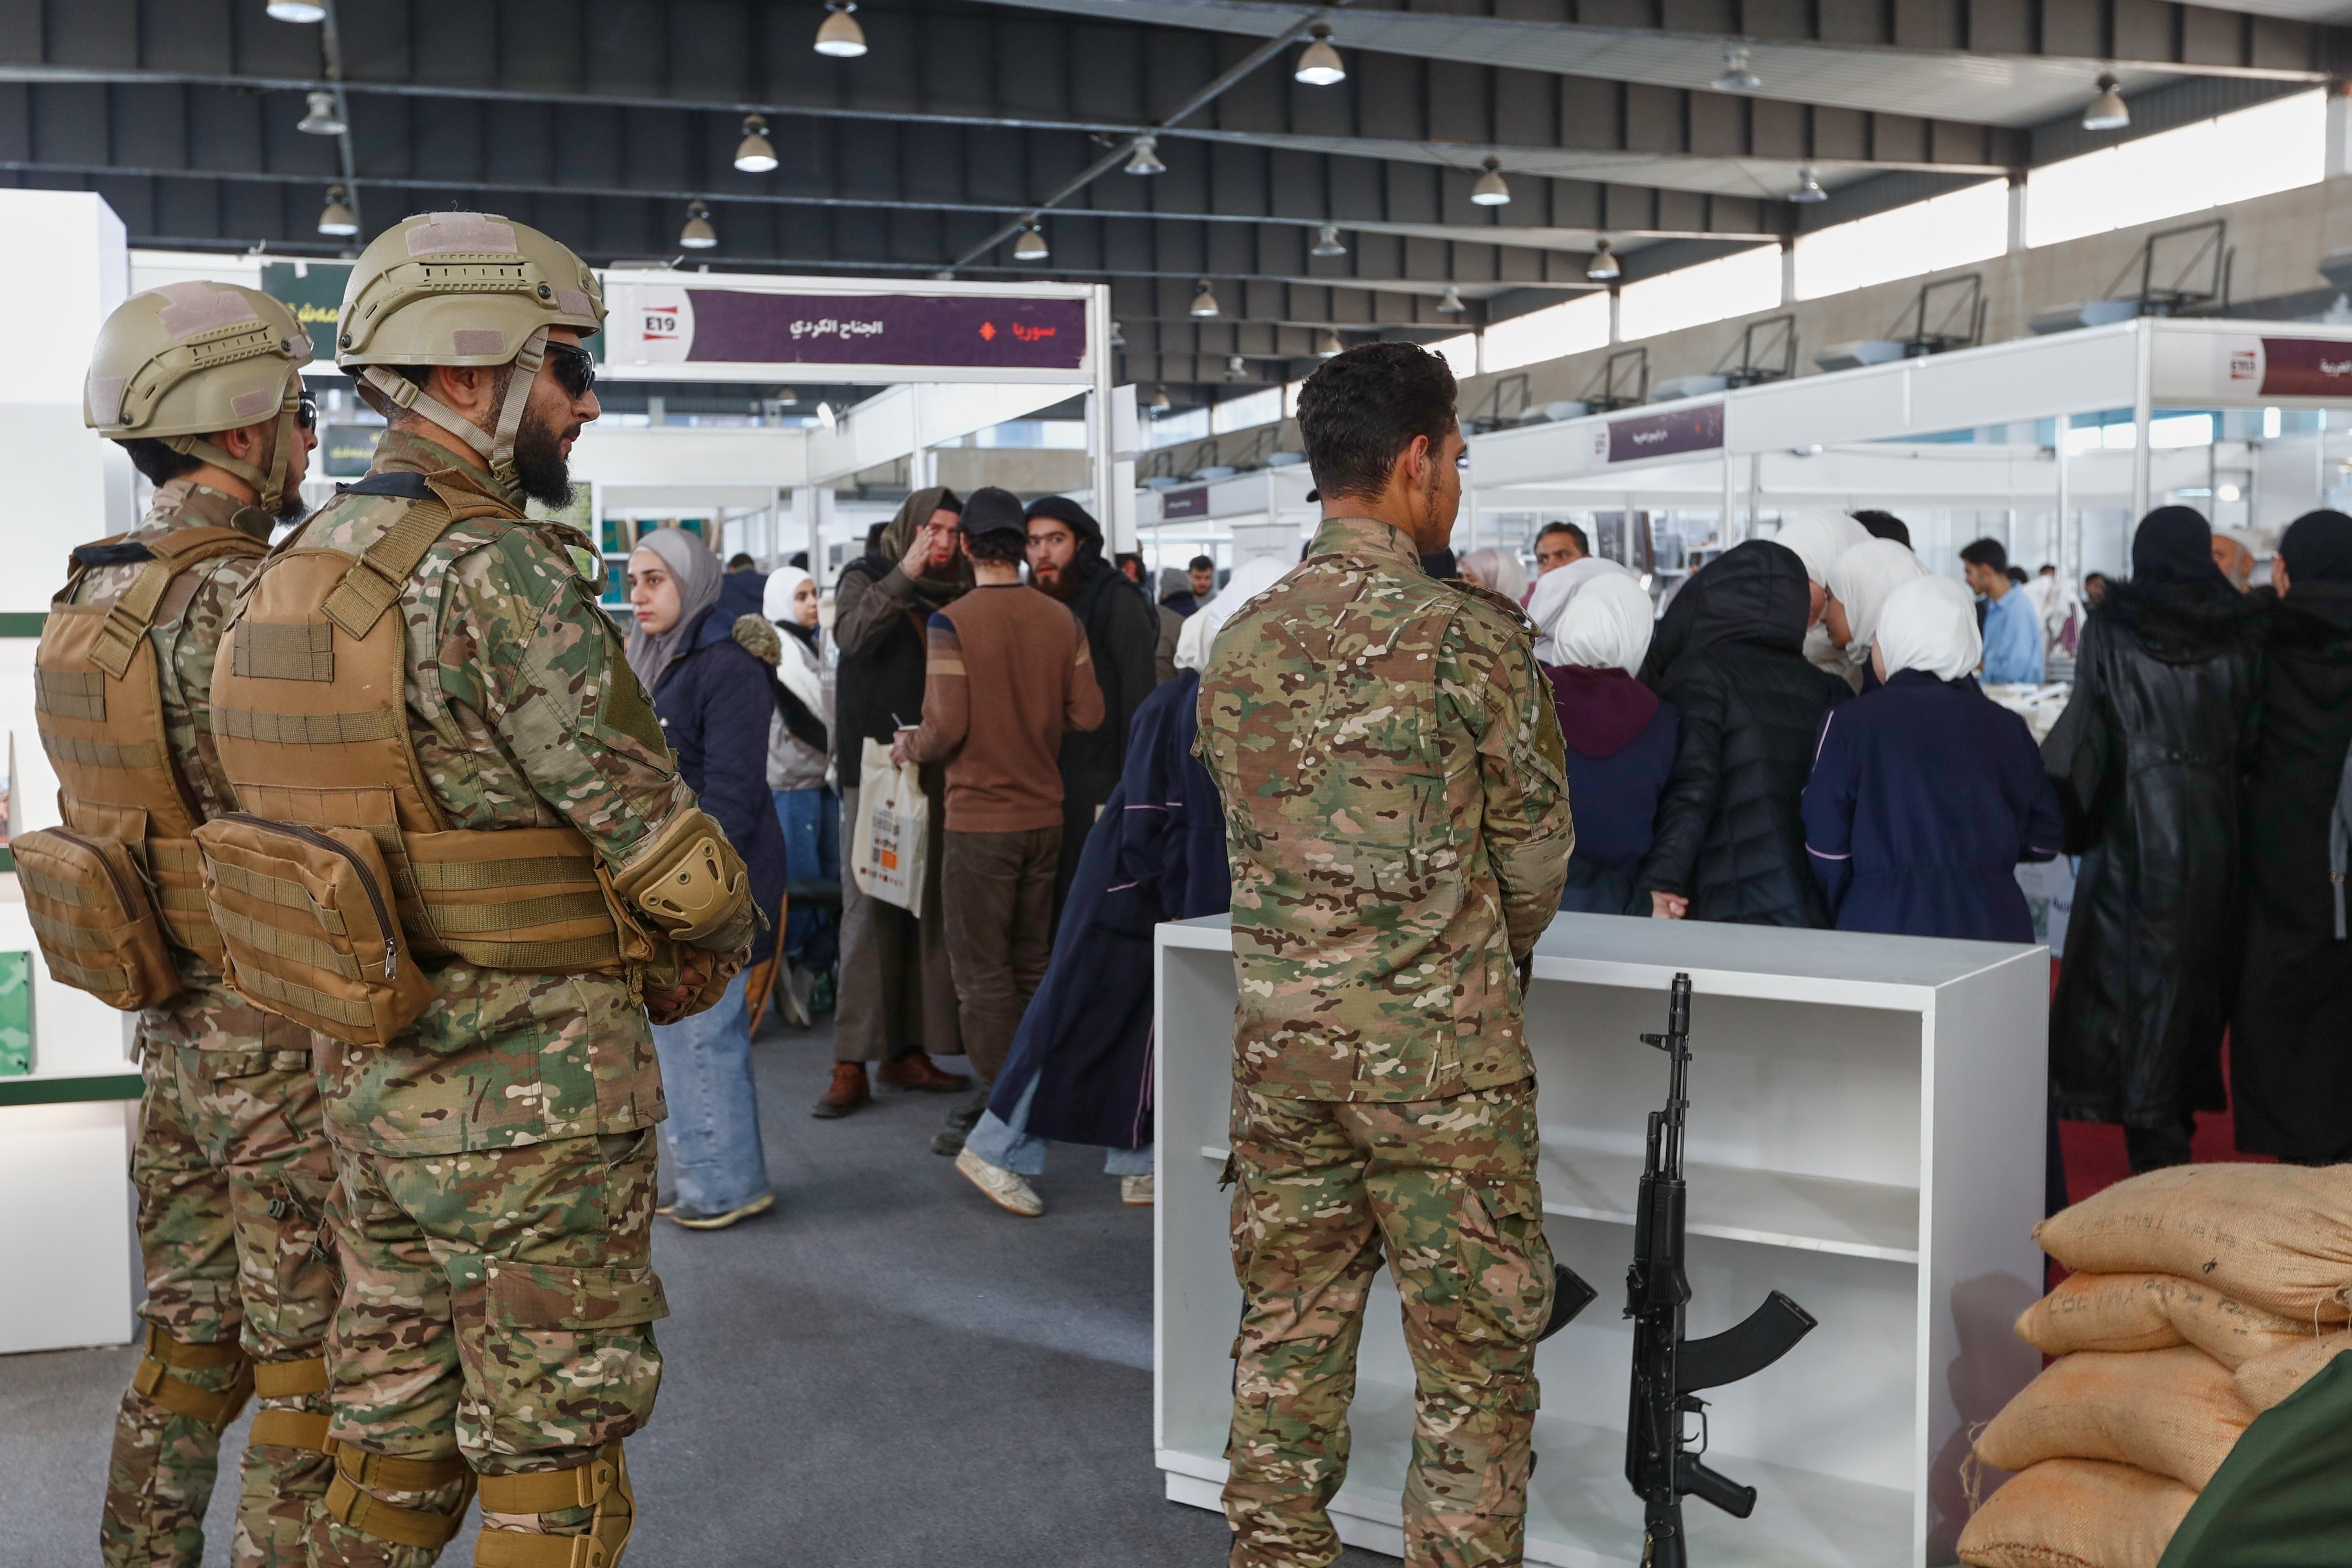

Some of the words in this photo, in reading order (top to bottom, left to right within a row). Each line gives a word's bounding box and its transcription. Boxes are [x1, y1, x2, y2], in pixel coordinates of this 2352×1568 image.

[646, 316, 675, 331] E19
[789, 318, 838, 340] الكردي
[839, 319, 884, 340] الجناح
[1012, 322, 1056, 342] سوريا
